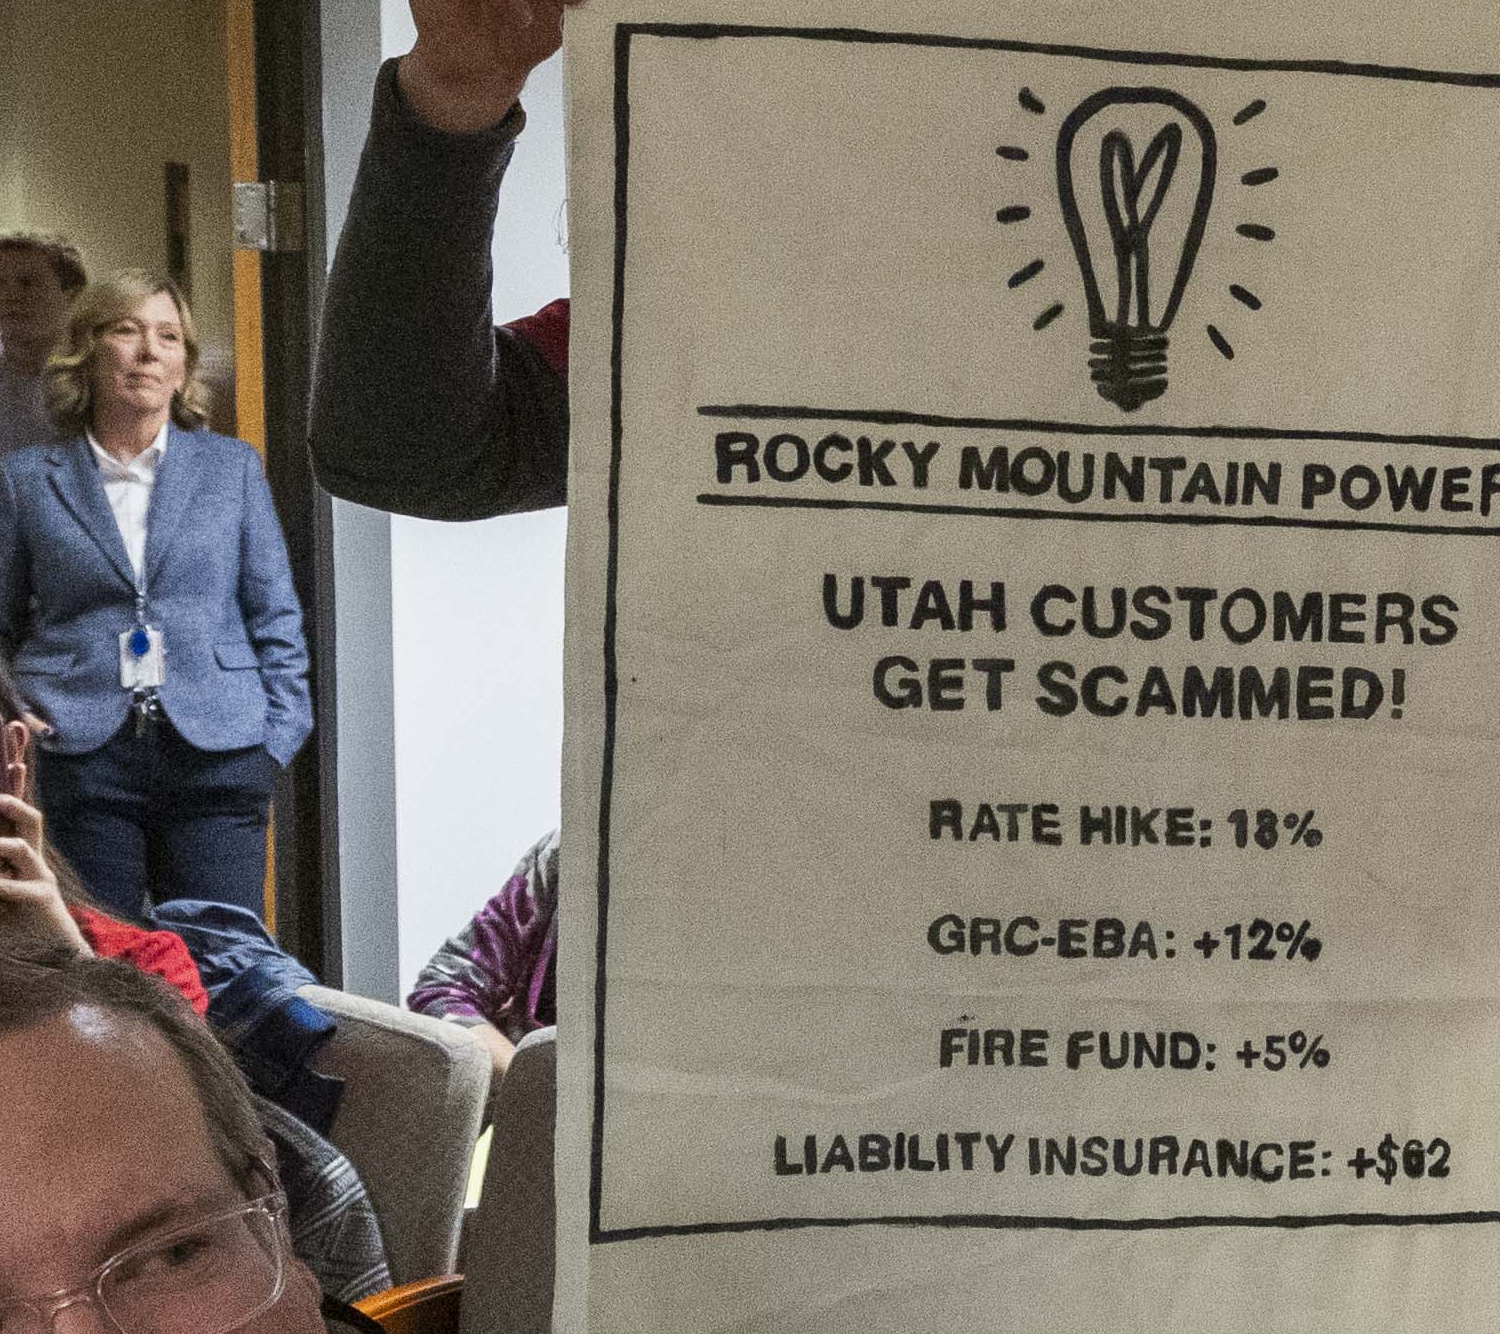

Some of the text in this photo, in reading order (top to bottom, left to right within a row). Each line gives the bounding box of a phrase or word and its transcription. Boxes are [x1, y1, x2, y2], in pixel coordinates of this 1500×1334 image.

[714, 431, 940, 489] ROCKY
[958, 446, 1282, 506] MOUNTAIN
[822, 573, 1458, 645] UTAH CUSTOMERS
[872, 655, 1406, 721] GET SCAMMED!
[928, 799, 1323, 850] RATE HIKE: 18%
[926, 913, 1323, 962] GRC-EBA: +12%
[939, 1028, 1332, 1072] FIRE FUND: +5%
[773, 1132, 1015, 1177] LIABILITY
[1028, 1135, 1332, 1183] INSURANCE:
